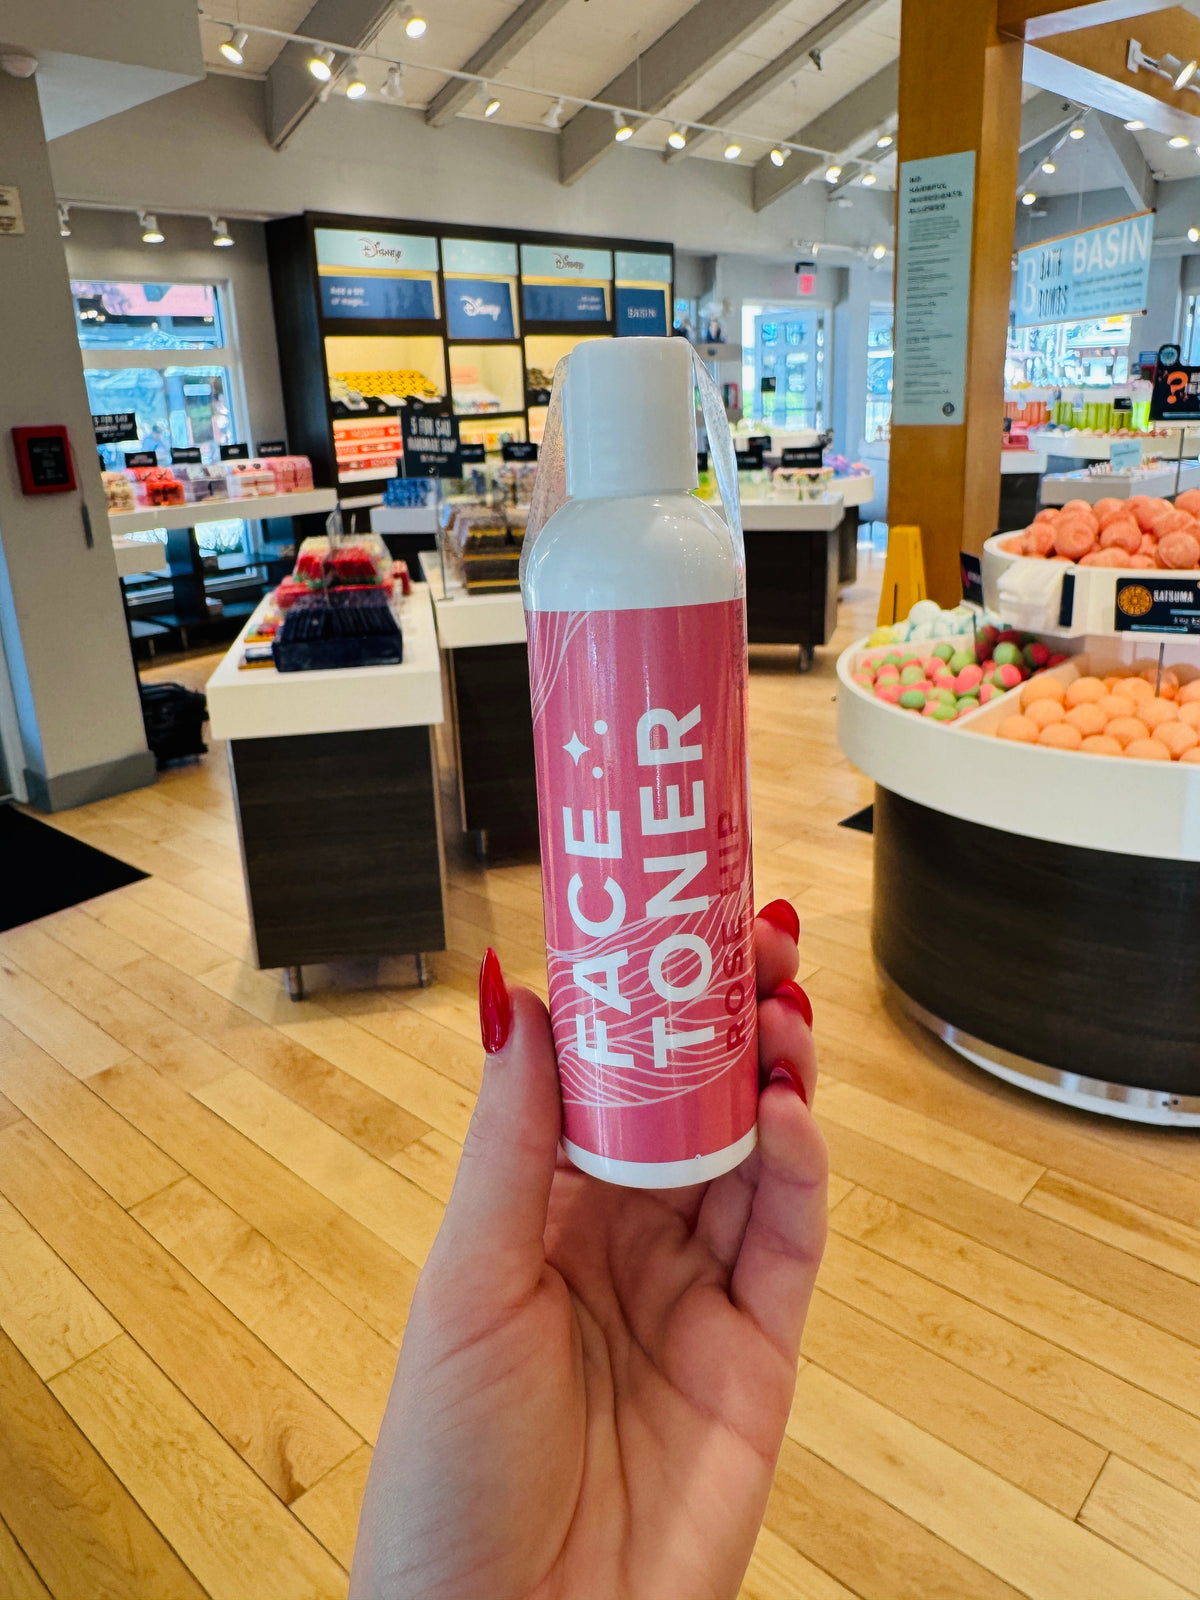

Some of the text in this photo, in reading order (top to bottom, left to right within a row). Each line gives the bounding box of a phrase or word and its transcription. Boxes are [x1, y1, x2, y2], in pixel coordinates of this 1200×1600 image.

[359, 238, 402, 264] Disney
[1071, 219, 1149, 275] BASIN
[553, 253, 585, 272] Disney
[460, 296, 501, 321] Disney
[627, 306, 657, 319] BASIN
[1152, 589, 1194, 603] SATSUMA
[636, 703, 716, 1069] TONER
[563, 807, 635, 1069] FACE
[717, 810, 747, 1051] ROSE HIP
